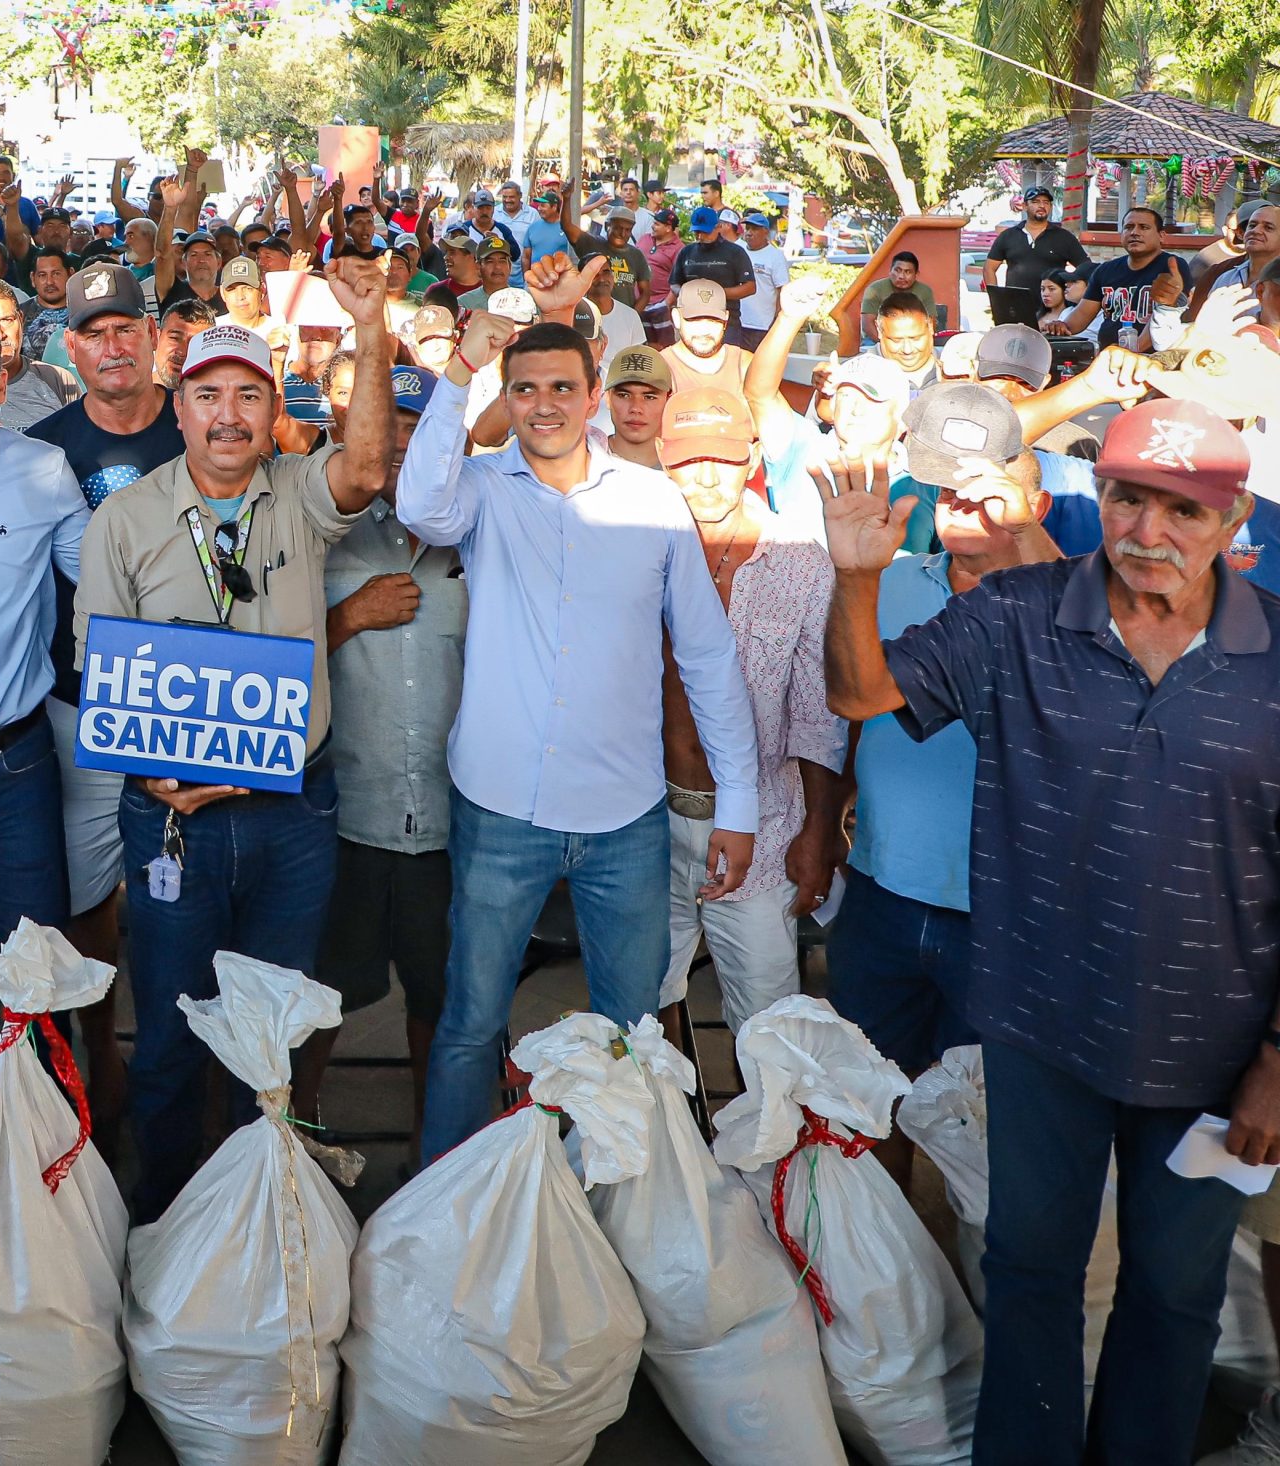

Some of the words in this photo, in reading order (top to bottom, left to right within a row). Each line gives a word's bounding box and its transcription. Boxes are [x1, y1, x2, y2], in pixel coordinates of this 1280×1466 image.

[202, 332, 250, 344] SANTANA
[85, 642, 309, 728] HÉCTOR
[91, 711, 296, 772] SANTANA
